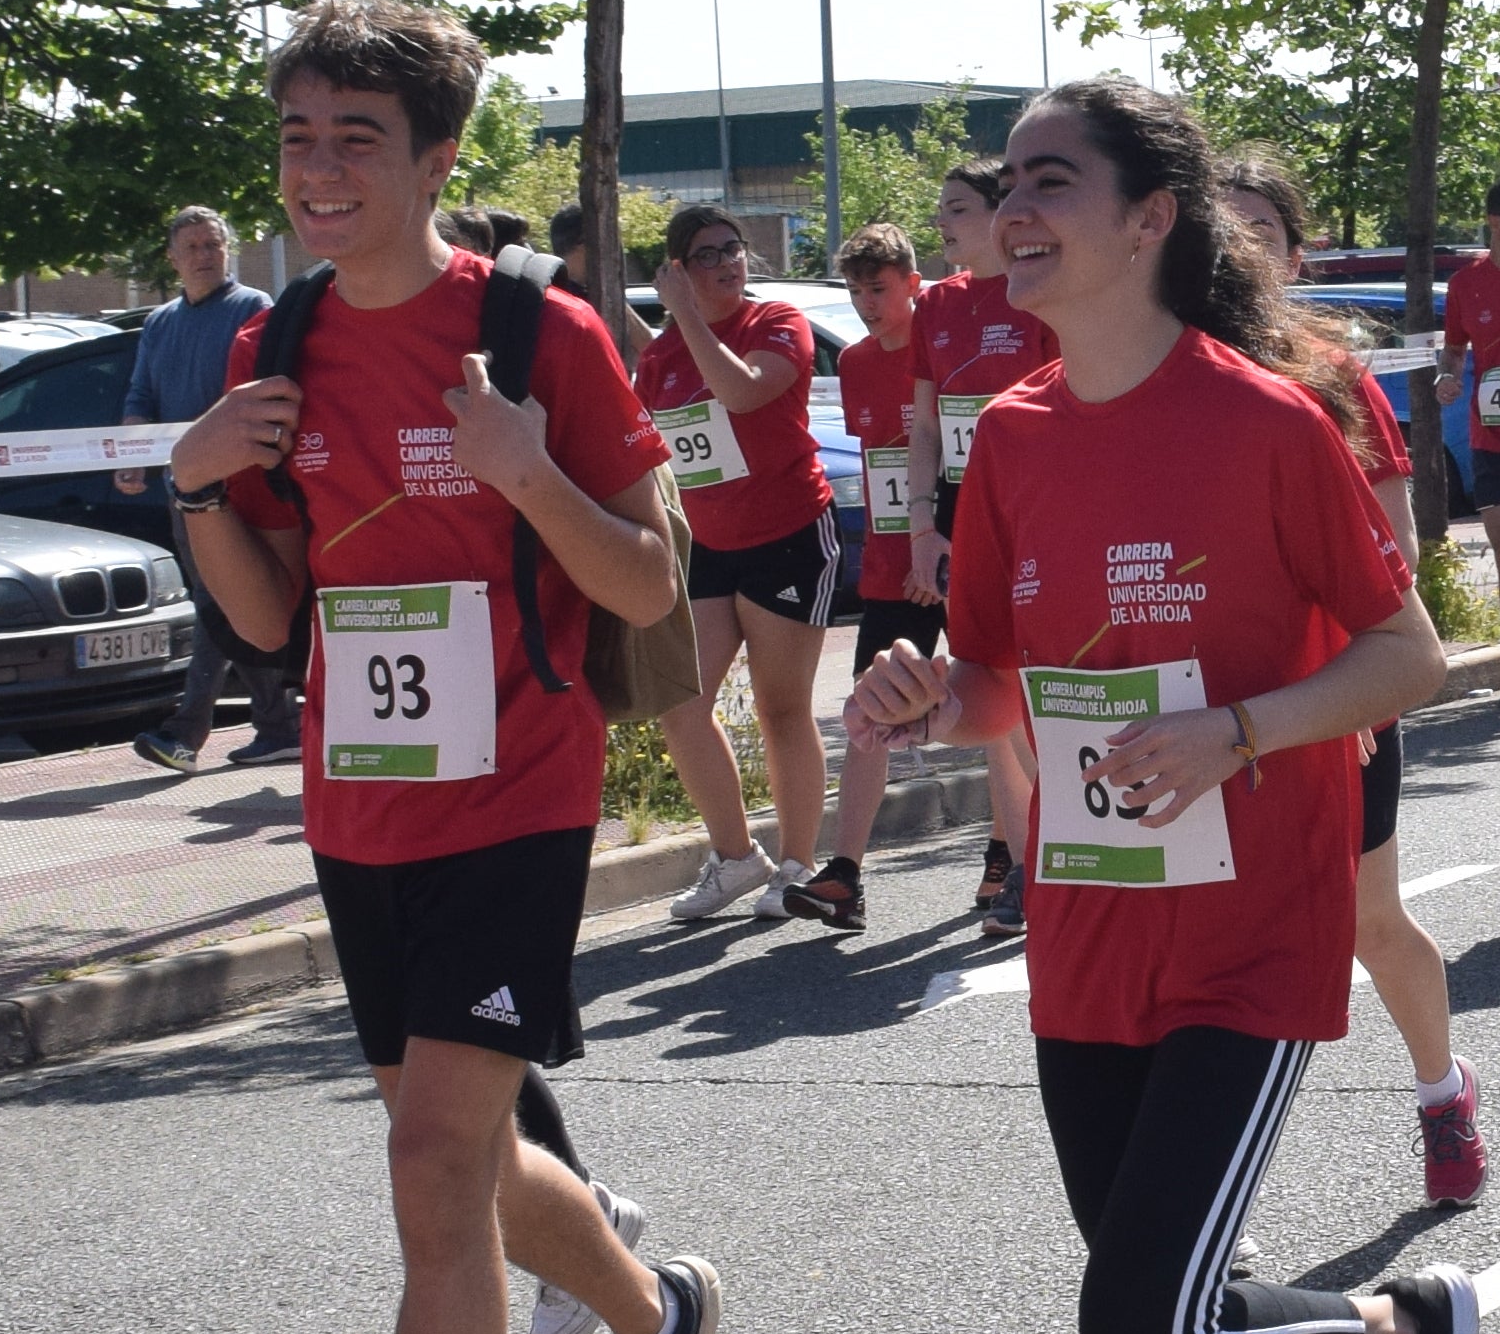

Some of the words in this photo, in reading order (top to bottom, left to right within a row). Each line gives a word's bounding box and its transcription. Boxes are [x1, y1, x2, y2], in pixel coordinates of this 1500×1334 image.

[400, 445, 452, 462] CAMPUS
[675, 433, 712, 463] 99
[404, 482, 421, 497] DE
[421, 481, 438, 497] LA
[439, 479, 479, 497] RIOJA
[886, 477, 909, 506] 1
[1106, 542, 1173, 563] CARRERA
[1106, 563, 1165, 584] CAMPUS
[1108, 584, 1207, 605] UNIVERSIDAD
[381, 613, 393, 626] DE
[393, 613, 405, 626] LA
[406, 611, 439, 625] RIOJA
[1111, 607, 1130, 626] DE
[1130, 606, 1148, 623] LA
[1150, 605, 1192, 623] RIOJA
[89, 635, 134, 661] 4381
[140, 629, 168, 655] CVG
[368, 654, 431, 720] 93
[1041, 681, 1075, 698] CARRERA
[1075, 685, 1106, 700] CAMPUS
[1041, 698, 1087, 715] UNIVERSIDAD
[1087, 702, 1099, 715] DE
[1100, 702, 1113, 715] LA
[1114, 699, 1148, 715] RIOJA
[471, 1005, 520, 1026] adidas
